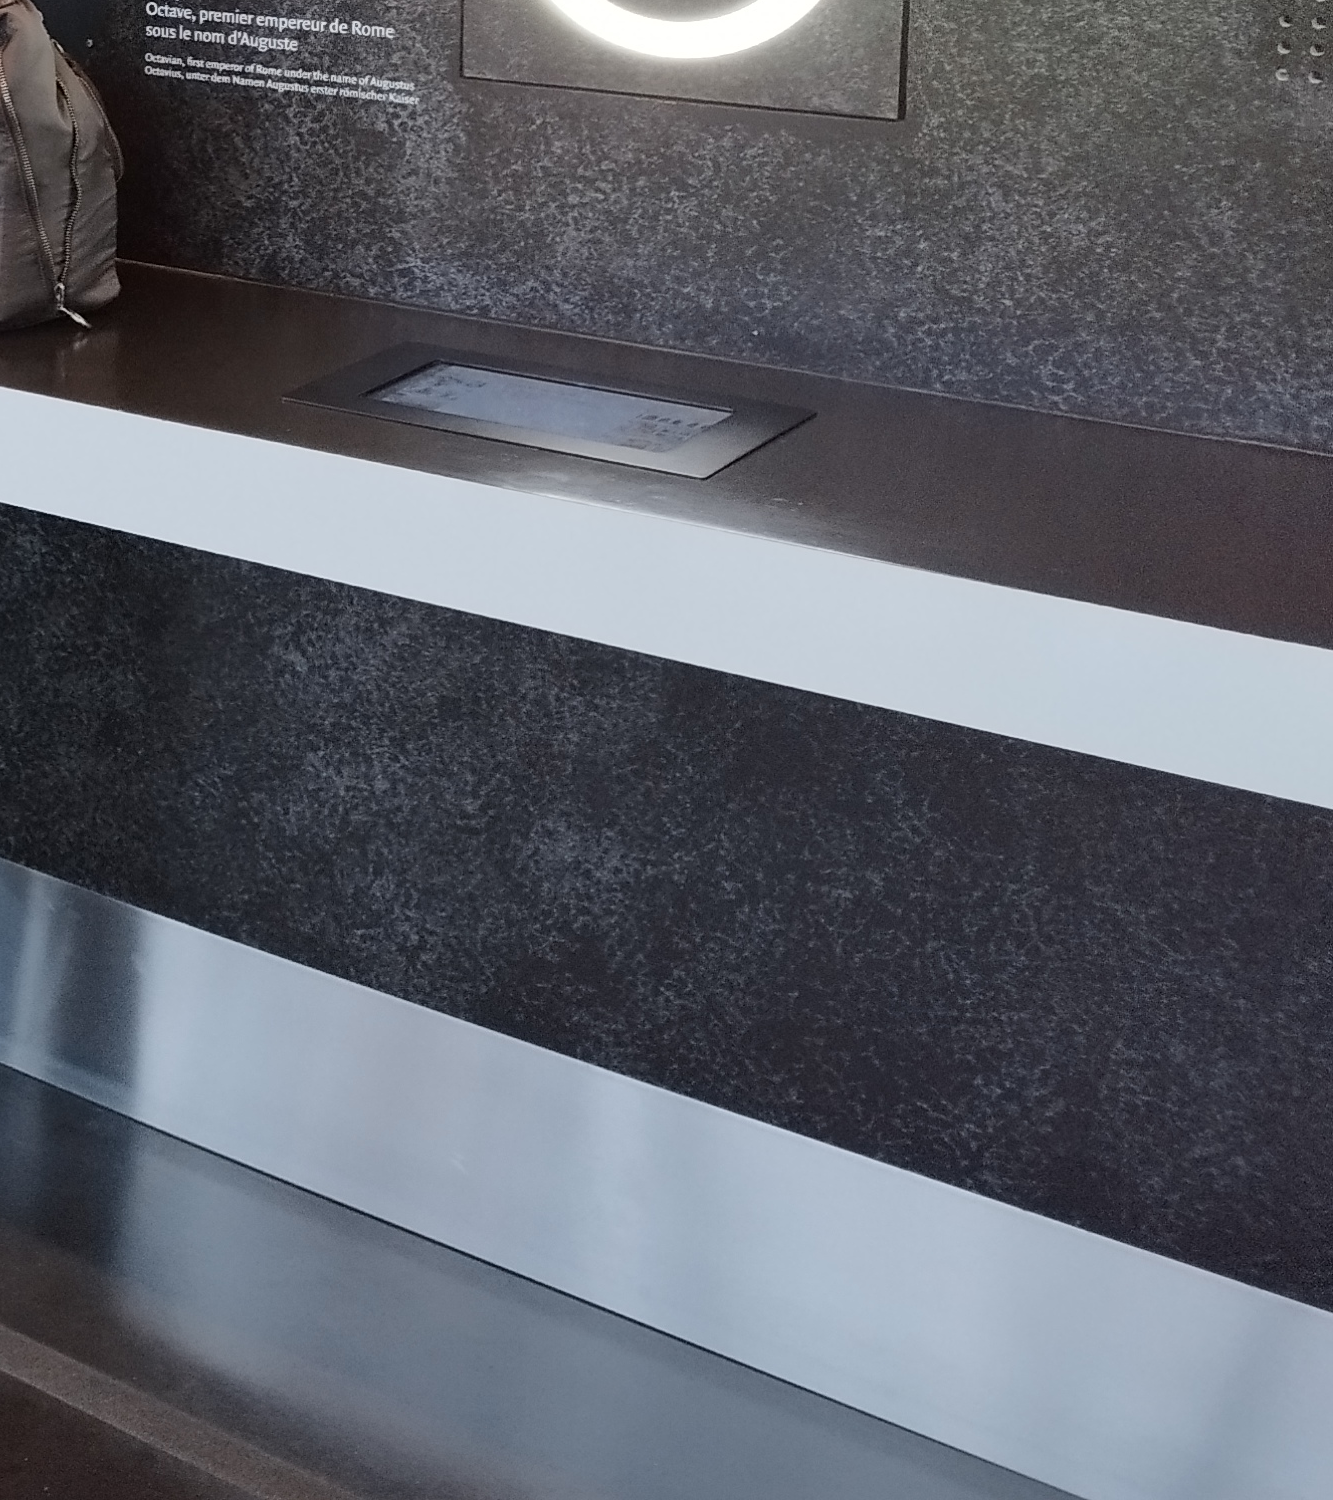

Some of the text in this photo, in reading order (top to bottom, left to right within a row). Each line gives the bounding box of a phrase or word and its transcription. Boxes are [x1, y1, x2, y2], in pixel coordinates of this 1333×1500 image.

[145, 1, 396, 38] Octave, premier empereur de Rome
[145, 25, 299, 52] sous le nom d'Auguste
[186, 56, 205, 68] first
[205, 60, 245, 73] emperor
[244, 62, 256, 73] of
[255, 64, 283, 76] Rome
[284, 68, 313, 80] under
[312, 70, 329, 81] the
[330, 73, 358, 85] name
[358, 75, 371, 86] of
[370, 76, 415, 91] Augustus
[210, 72, 231, 84] dem
[232, 74, 265, 88] Namen
[266, 80, 309, 93] Augustus
[310, 85, 339, 96] erster
[388, 92, 420, 105] Kaiser
